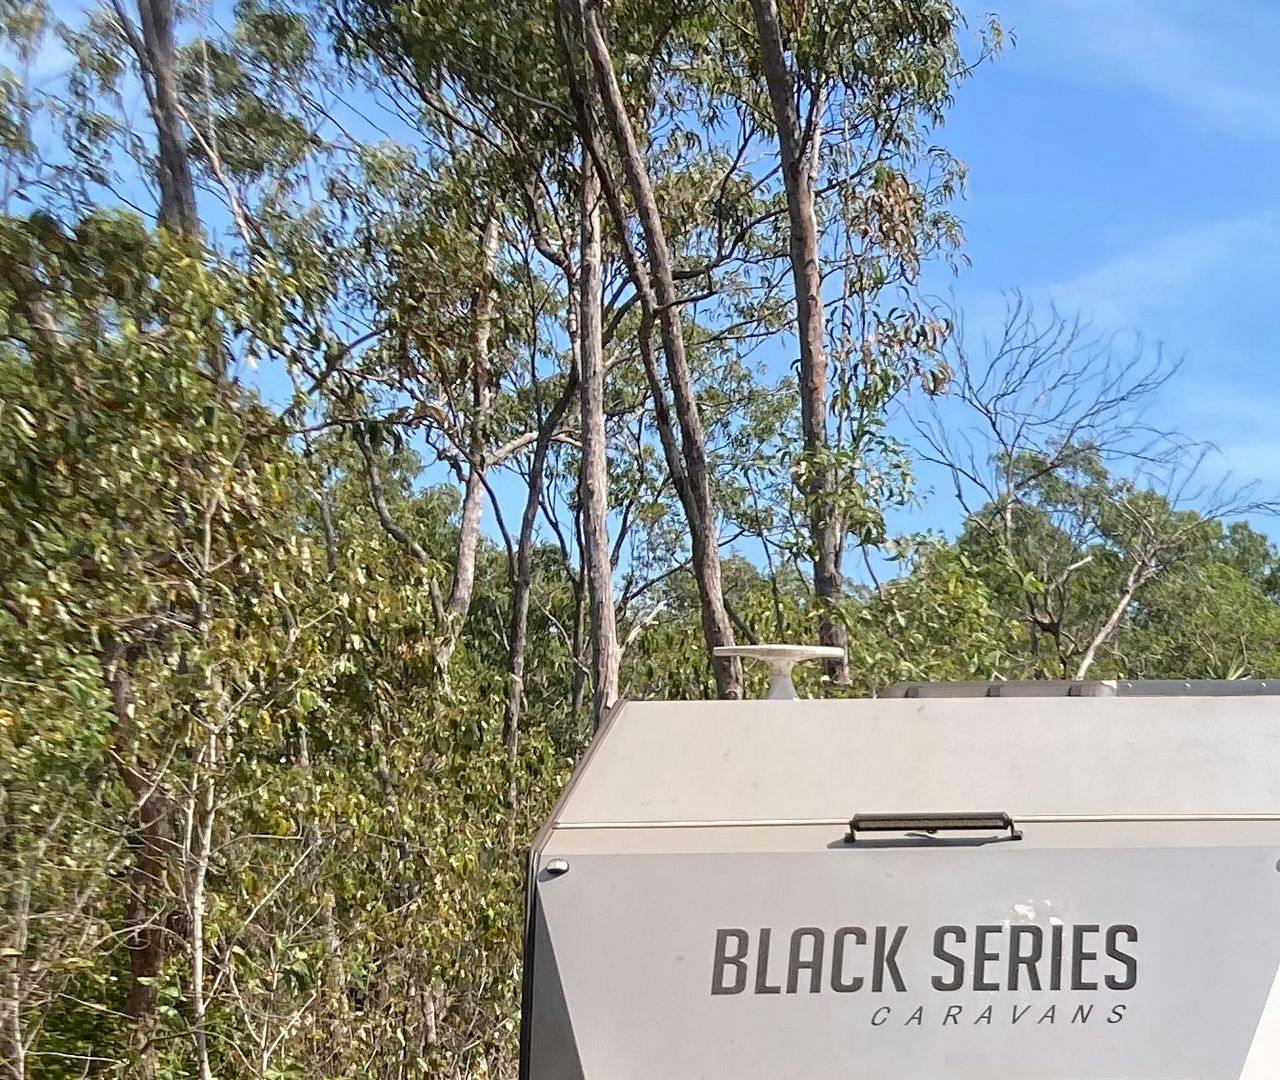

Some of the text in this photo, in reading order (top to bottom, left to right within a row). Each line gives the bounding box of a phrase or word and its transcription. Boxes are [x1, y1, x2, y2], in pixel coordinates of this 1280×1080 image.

[711, 925, 1138, 995] BLACK SERIES
[870, 1004, 1126, 1026] CARAVANS
